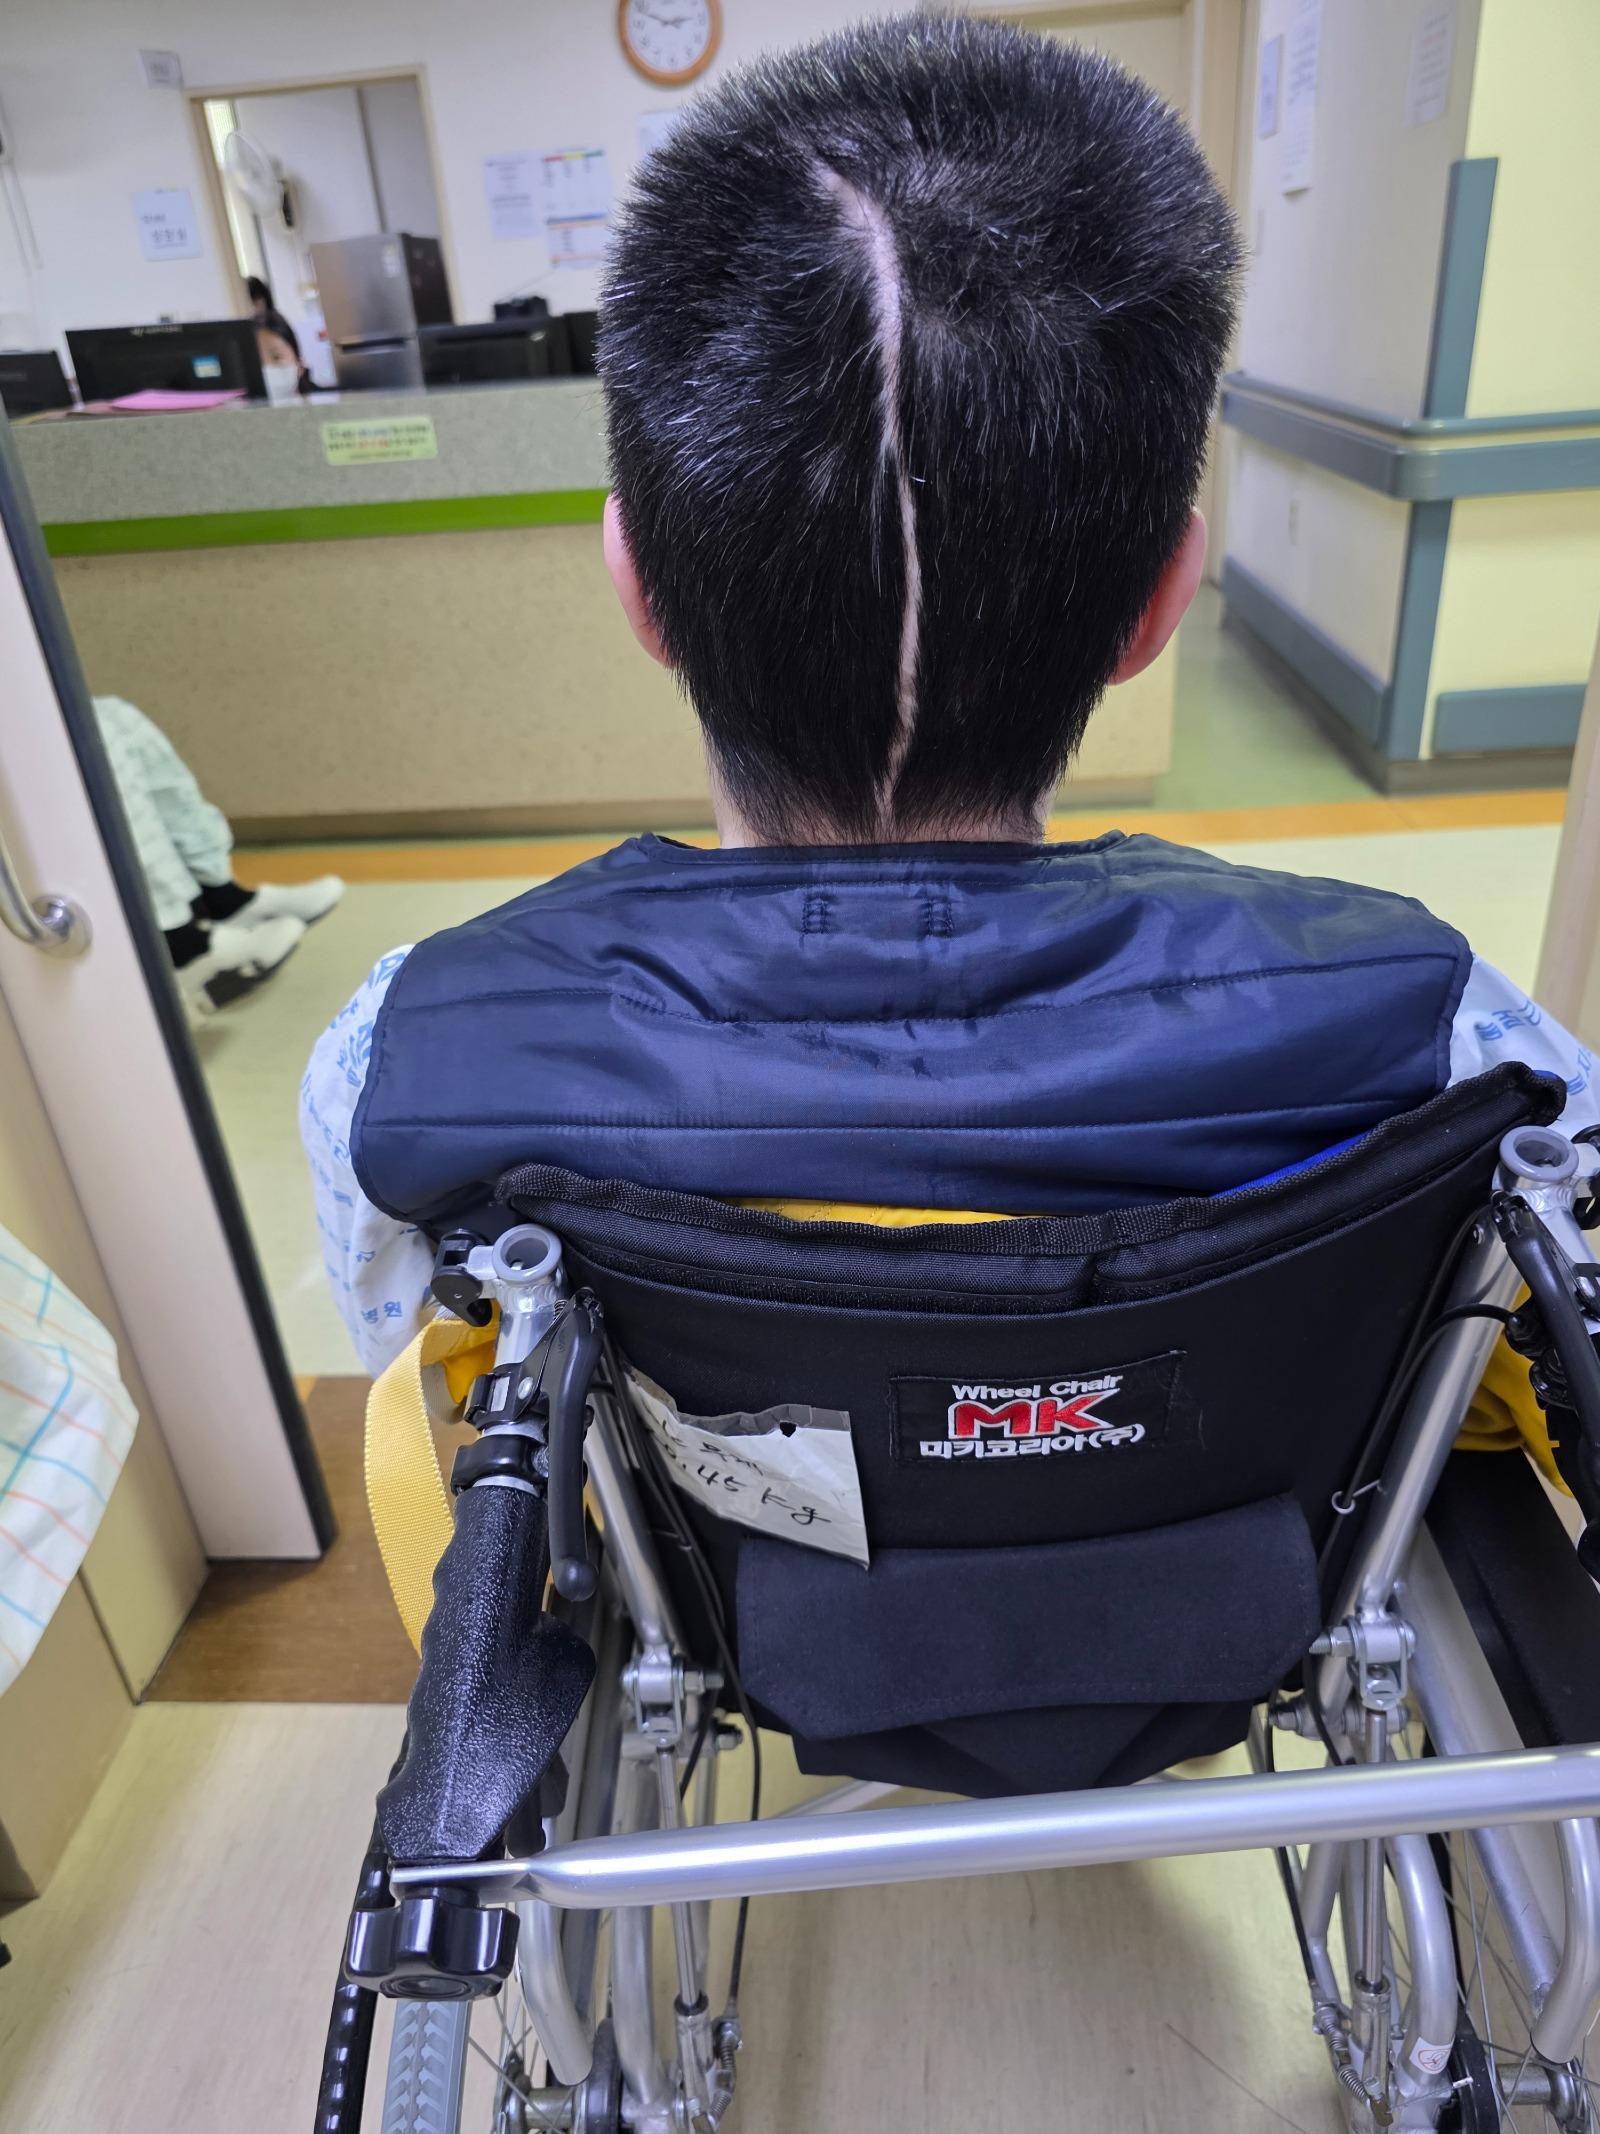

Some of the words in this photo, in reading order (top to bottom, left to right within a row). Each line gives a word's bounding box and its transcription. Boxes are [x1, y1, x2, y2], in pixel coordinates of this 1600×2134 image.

[951, 1385, 1041, 1400] Wheel
[1049, 1375, 1123, 1396] Chair
[948, 1388, 1120, 1440] MK
[919, 1423, 1146, 1459] 미키코리아(주)
